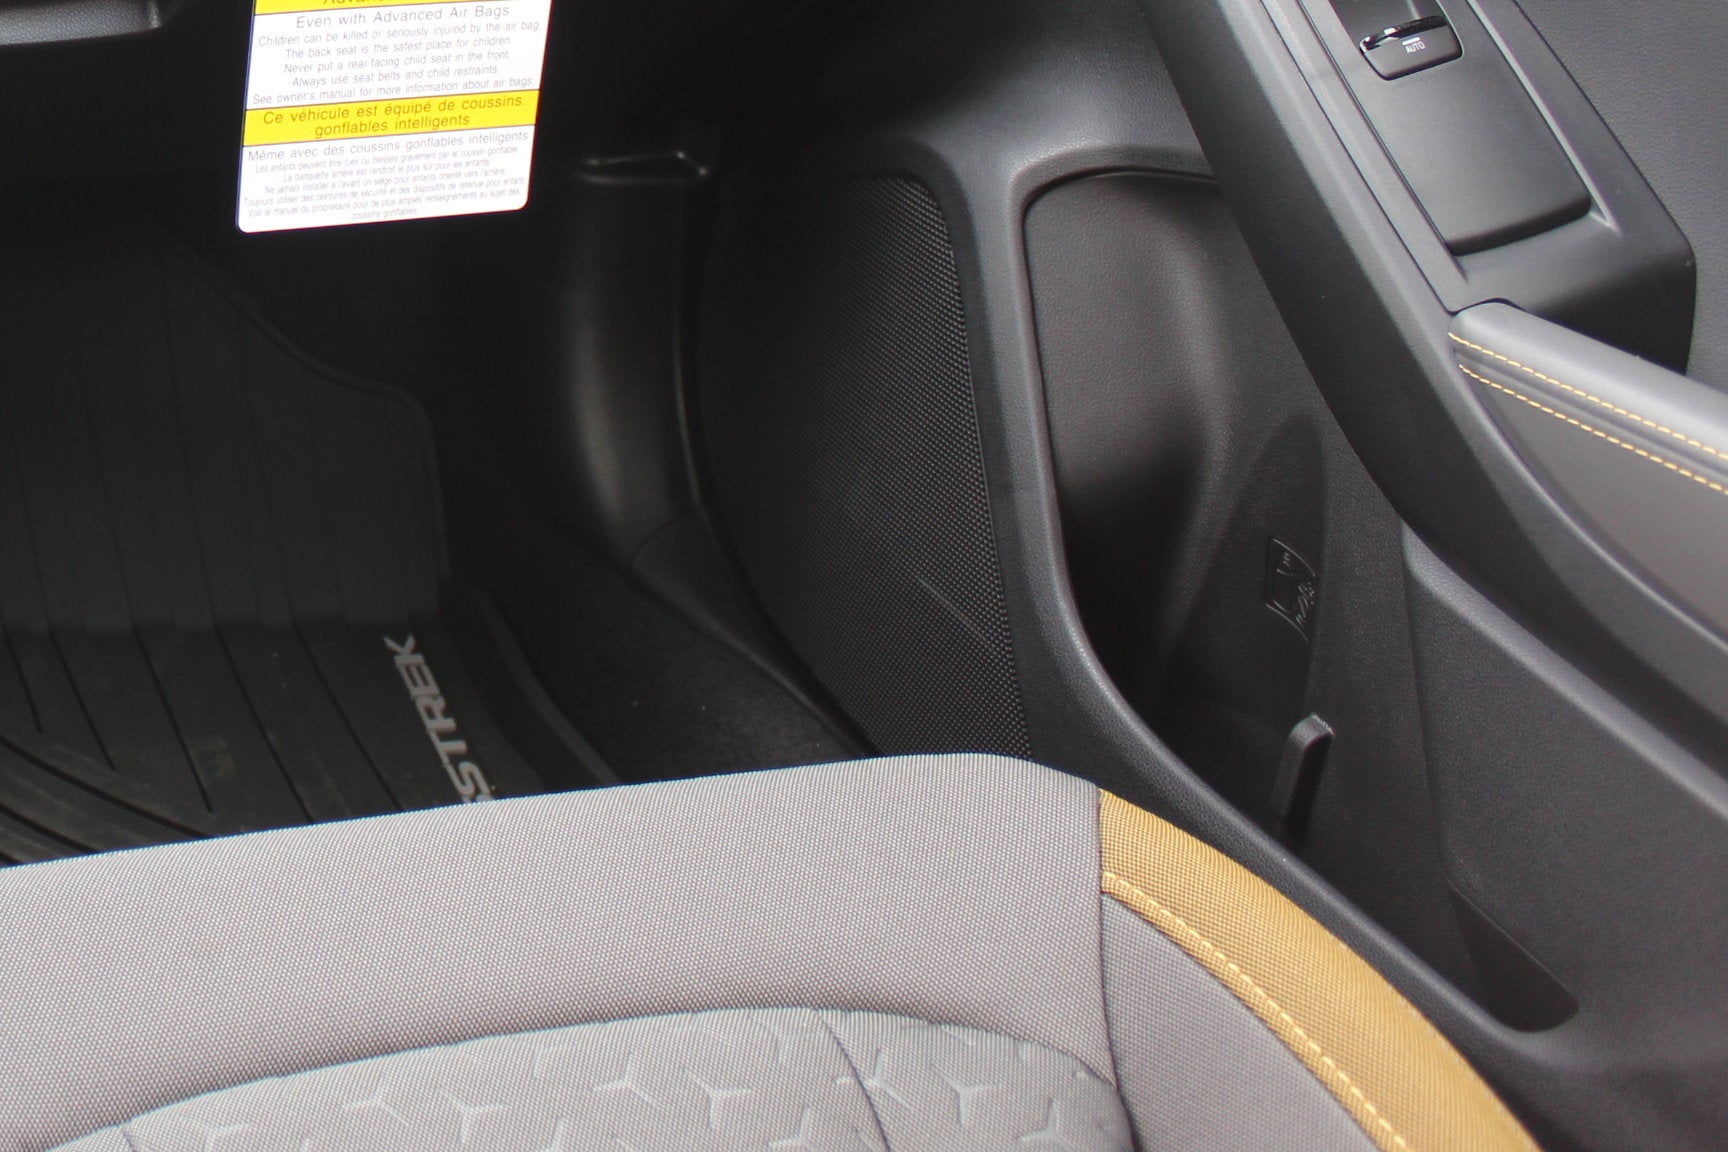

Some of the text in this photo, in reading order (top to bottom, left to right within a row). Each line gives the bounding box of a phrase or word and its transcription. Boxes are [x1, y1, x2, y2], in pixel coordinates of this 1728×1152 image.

[297, 5, 510, 28] Even with Advanced Air Bags
[259, 36, 300, 47] Children
[304, 34, 322, 44] can
[326, 32, 338, 42] be
[486, 22, 500, 31] the
[286, 49, 304, 58] The
[308, 47, 332, 58] back
[336, 46, 357, 56] seat
[374, 43, 388, 53] the
[1405, 42, 1426, 53] AUTO
[284, 64, 313, 74] Never
[292, 77, 327, 88] Always
[353, 74, 374, 83] seat
[405, 70, 423, 80] and
[253, 94, 272, 104] See
[277, 91, 315, 103] owner's
[320, 88, 356, 100] manual
[360, 87, 372, 97] for
[377, 85, 401, 96] more
[462, 79, 489, 90] about
[263, 95, 522, 125] Ce véhicule est équipé de coussins
[315, 114, 470, 139] gonflables intelligents
[248, 131, 528, 161] Même avec des coussins gonflables intelligents
[384, 633, 494, 803] STREK
